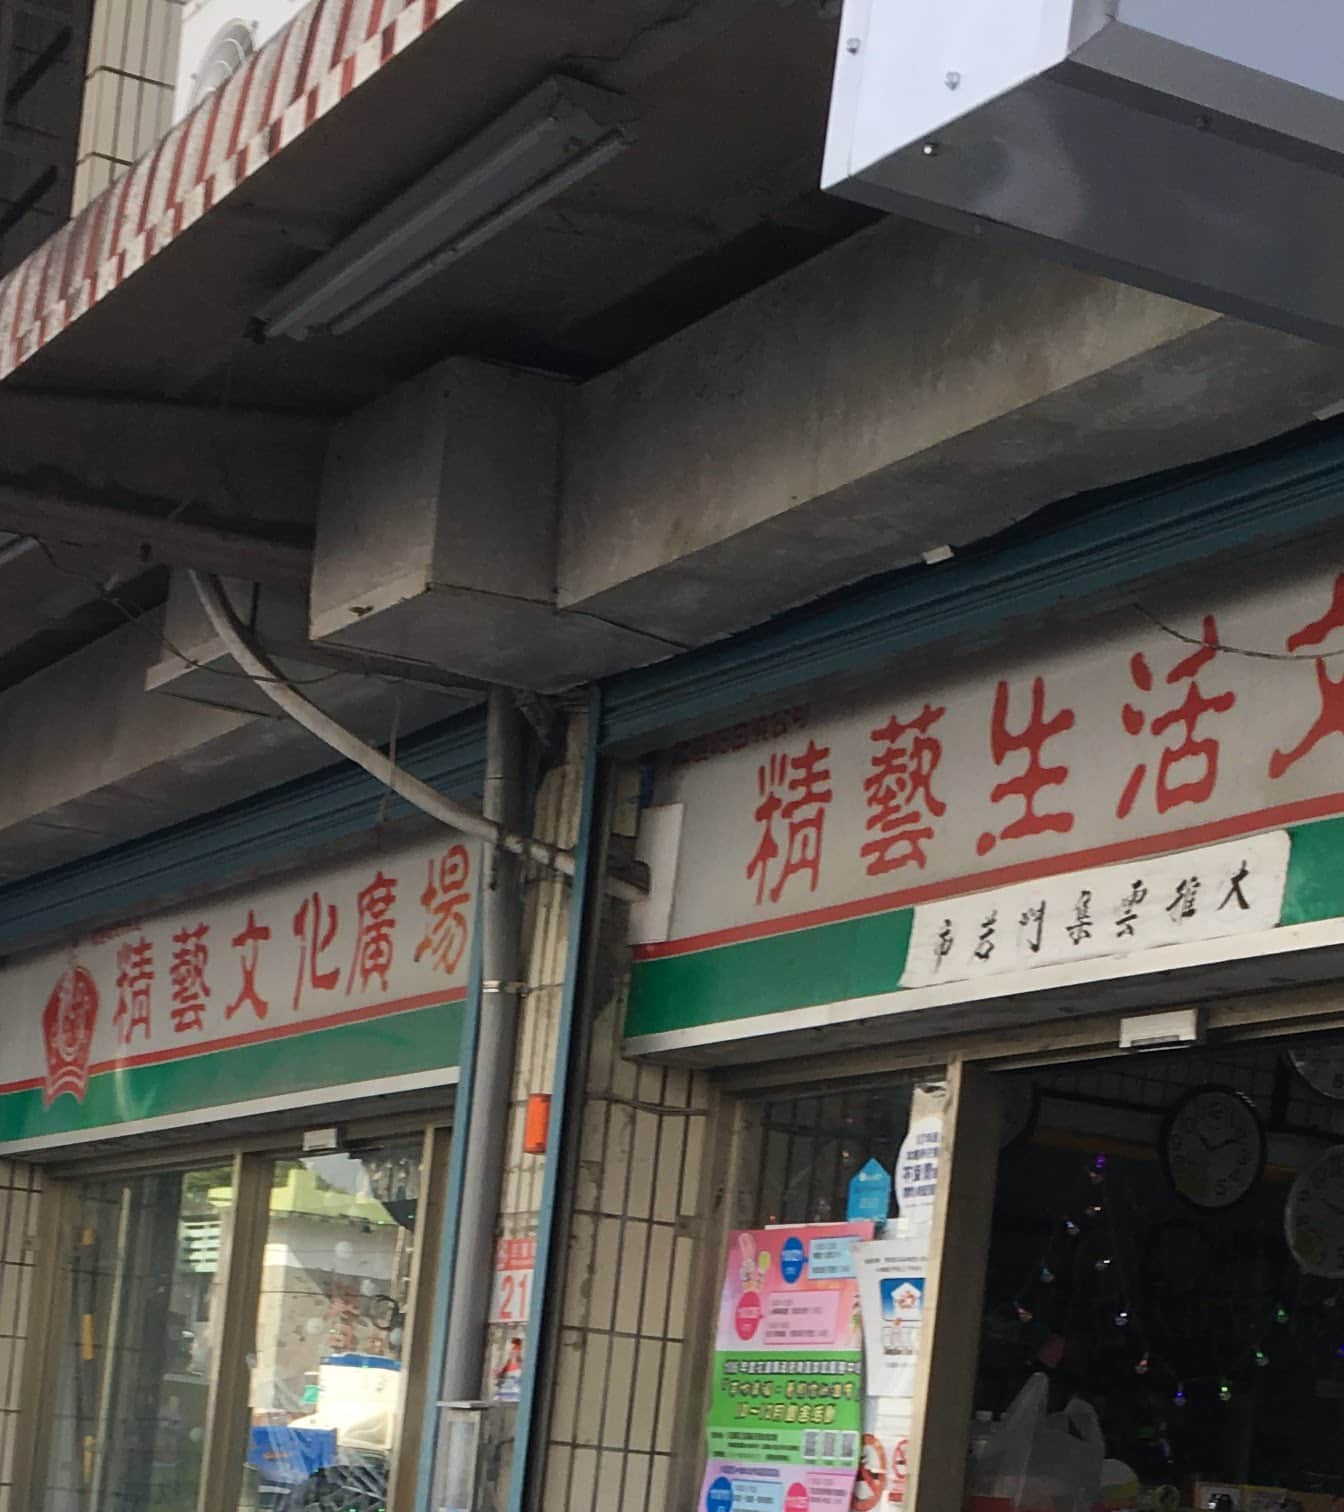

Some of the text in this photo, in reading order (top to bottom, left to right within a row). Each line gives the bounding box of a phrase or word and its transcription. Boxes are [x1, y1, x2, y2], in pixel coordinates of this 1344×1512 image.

[112, 843, 472, 1046] 精藝文化廣場
